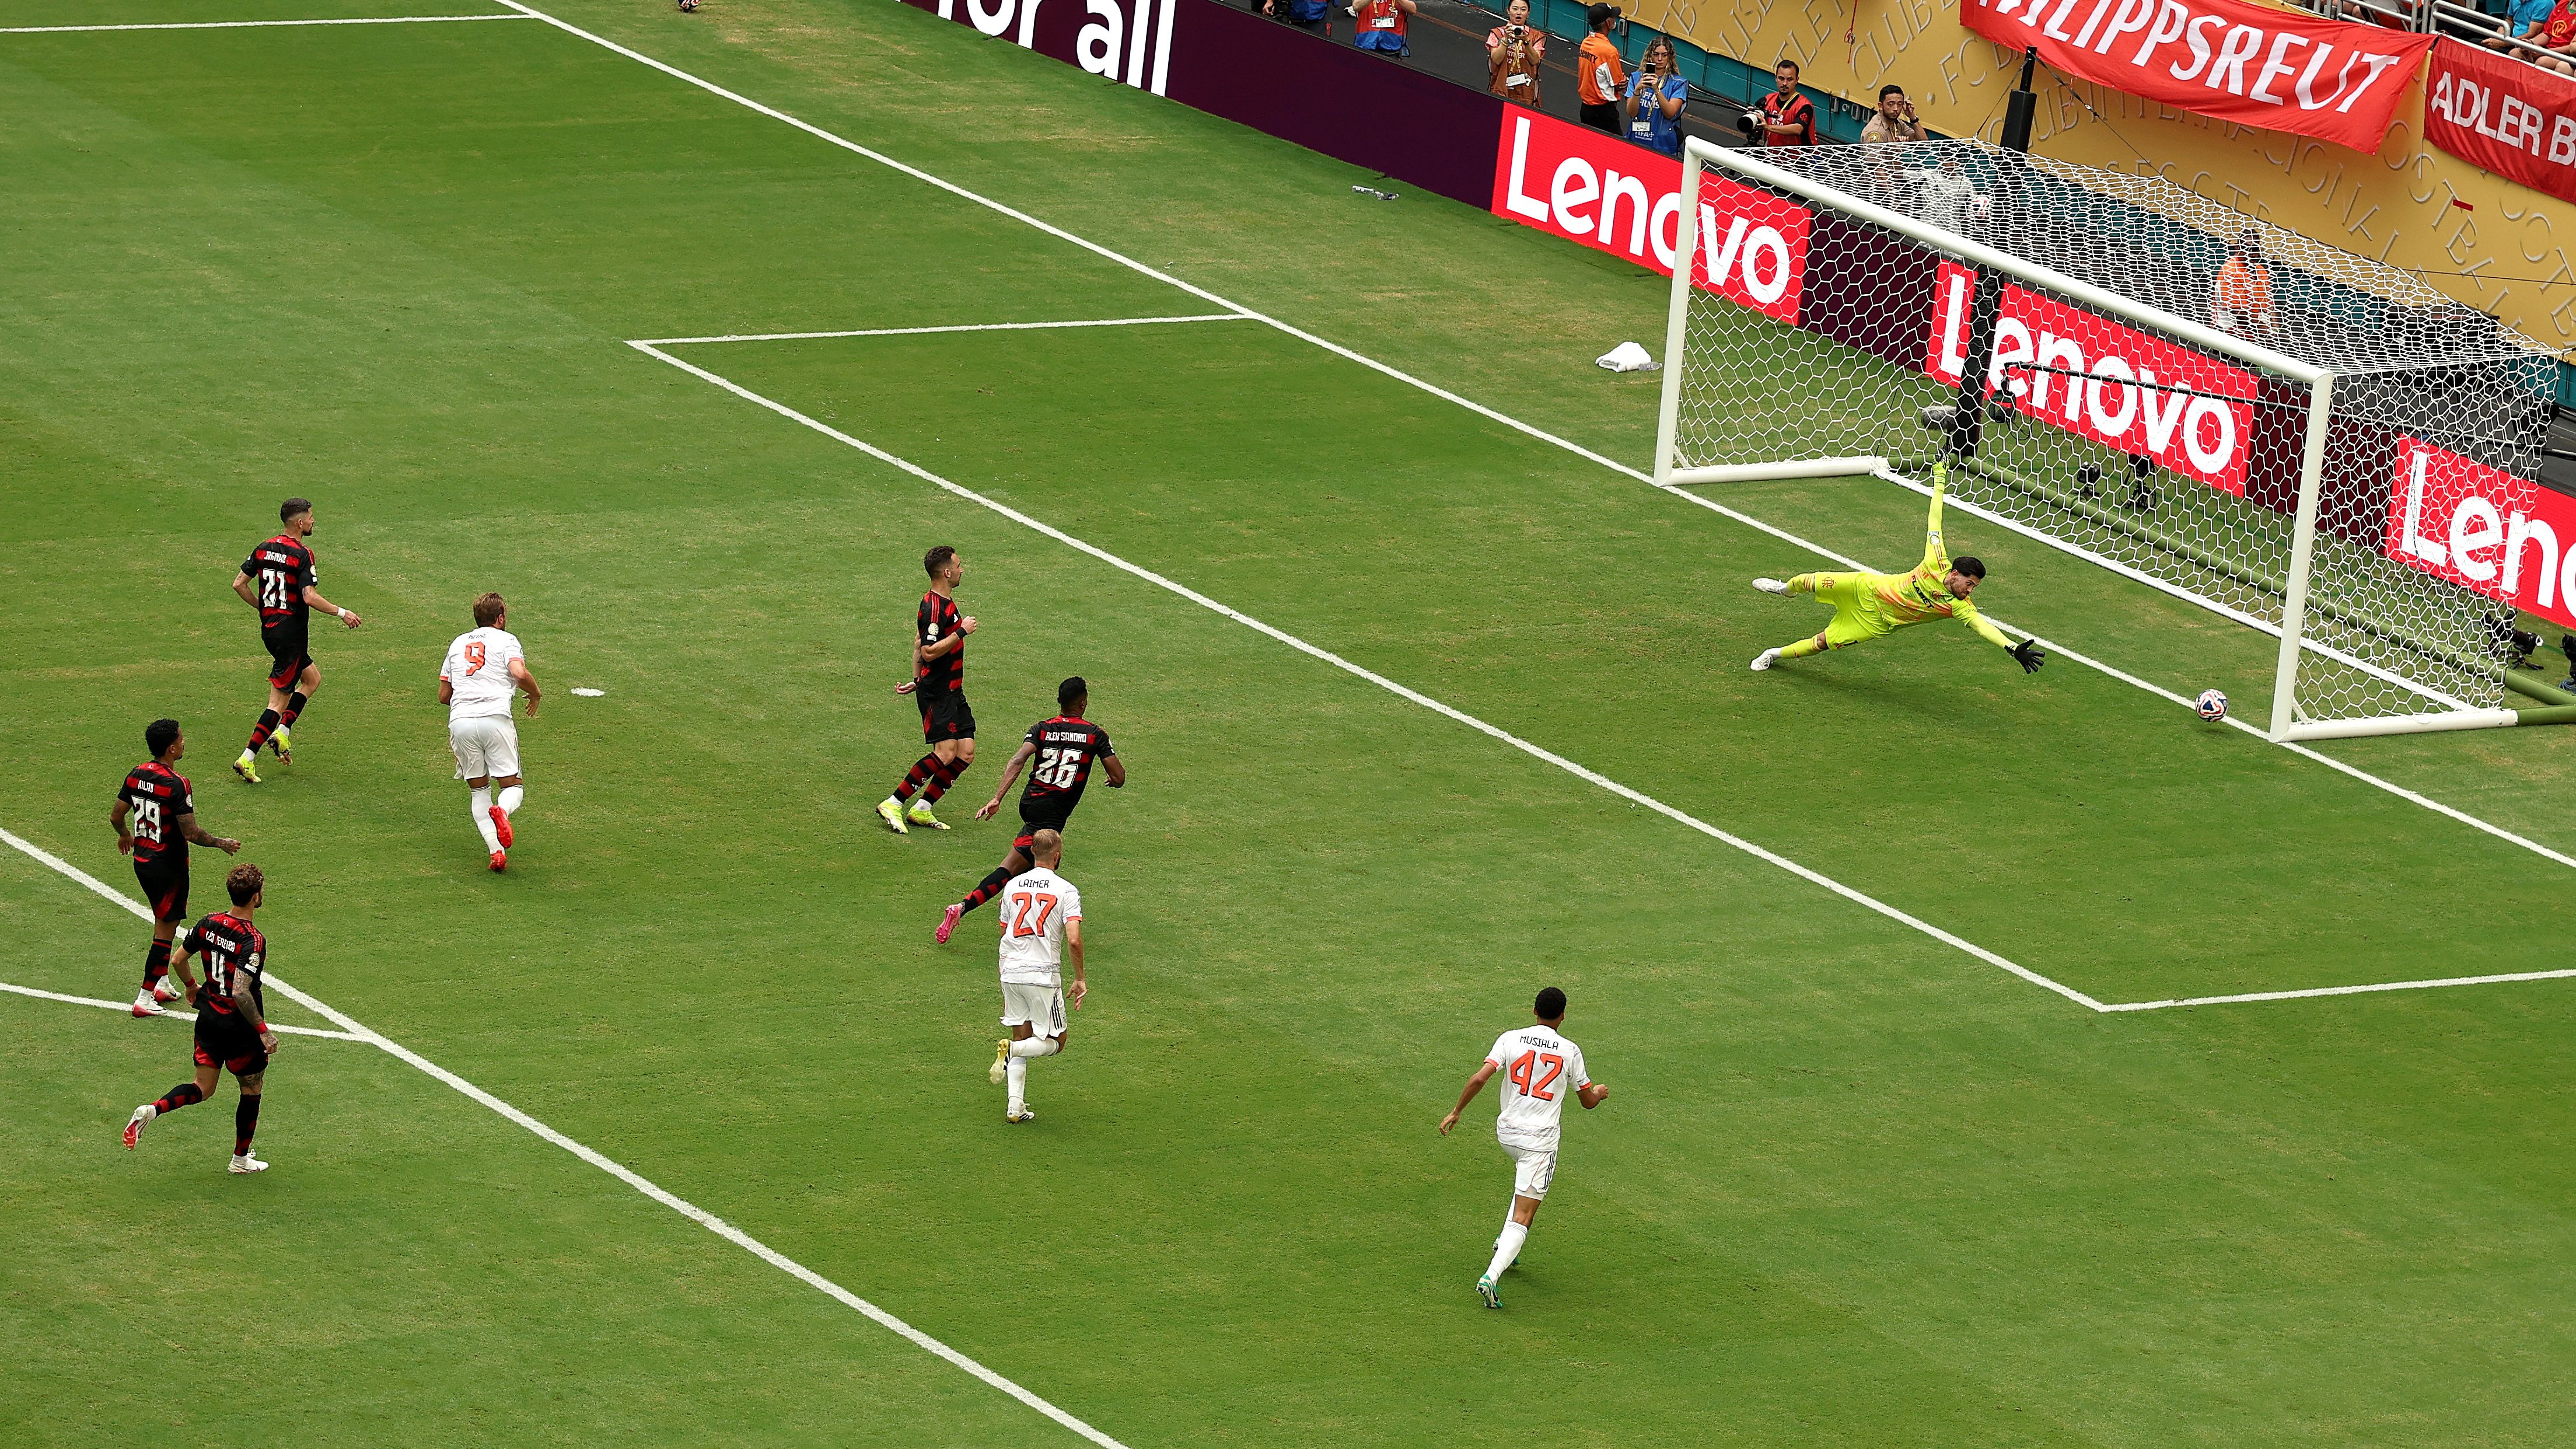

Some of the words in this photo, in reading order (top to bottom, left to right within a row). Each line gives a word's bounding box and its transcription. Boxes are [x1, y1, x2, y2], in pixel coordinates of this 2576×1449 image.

[938, 0, 1042, 50] or
[1076, 0, 1176, 97] all
[1979, 0, 2400, 113] LIPPSREUT
[2431, 71, 2543, 156] ADLER
[2547, 114, 2576, 166] B
[1507, 116, 1790, 304] Lenovo
[1941, 273, 2236, 474] Lenovo
[263, 568, 288, 610] 21
[464, 641, 486, 676] 9
[1045, 731, 1060, 741] ALEX
[1061, 732, 1087, 743] SANDRO
[1035, 747, 1083, 788] 26
[131, 795, 162, 844] 29
[1019, 879, 1050, 888] LAIMER
[1012, 892, 1058, 938] 27
[211, 950, 227, 996] 4
[1520, 1035, 1559, 1050] MUSIALA
[1511, 1050, 1564, 1102] 42
